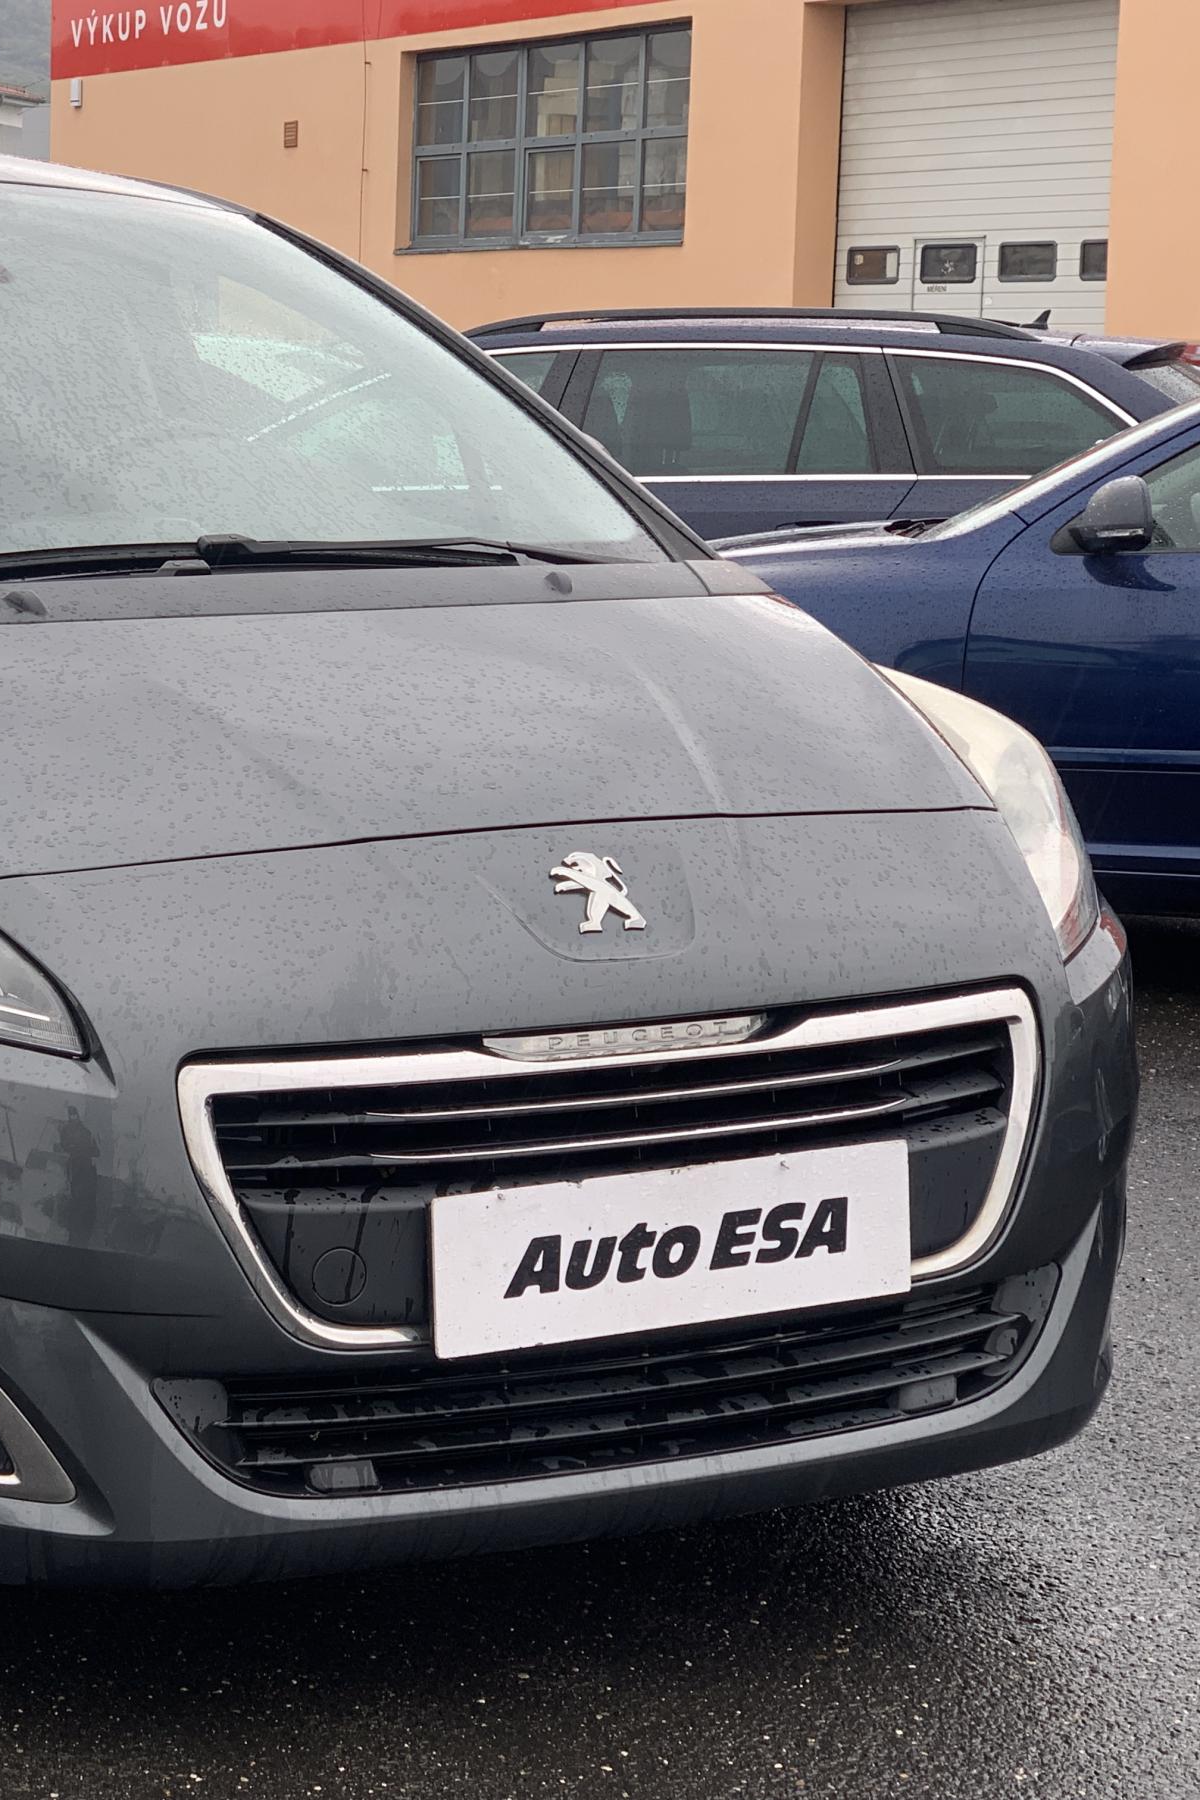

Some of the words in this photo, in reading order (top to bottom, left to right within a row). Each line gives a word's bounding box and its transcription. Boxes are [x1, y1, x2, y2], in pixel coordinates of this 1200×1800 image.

[71, 9, 147, 48] VÝKUP
[547, 1020, 728, 1050] PEUGEOT
[503, 1222, 701, 1299] Auto
[709, 1196, 848, 1271] ESA
